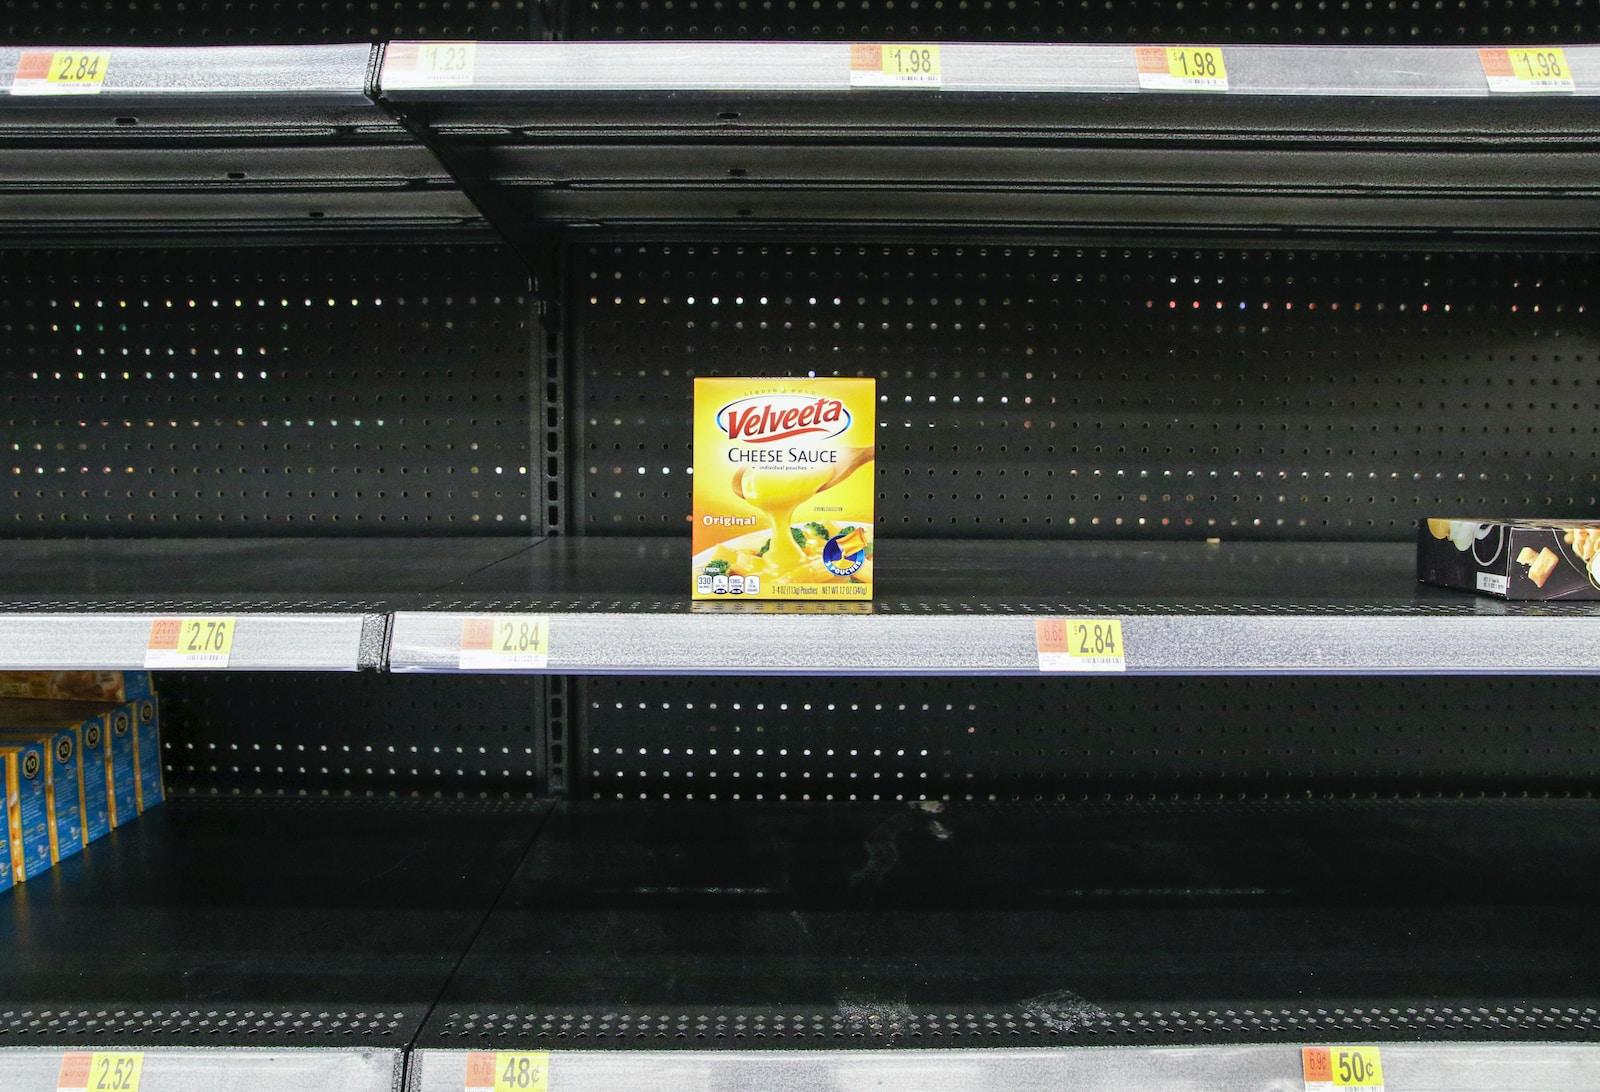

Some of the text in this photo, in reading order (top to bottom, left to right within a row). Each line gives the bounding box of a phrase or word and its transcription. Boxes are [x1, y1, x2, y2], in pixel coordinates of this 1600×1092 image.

[728, 398, 842, 439] Velveeta
[728, 448, 837, 463] CHEESE SAUCE
[703, 514, 757, 528] Original
[698, 576, 711, 585] 330
[1339, 1051, 1374, 1083] 50¢
